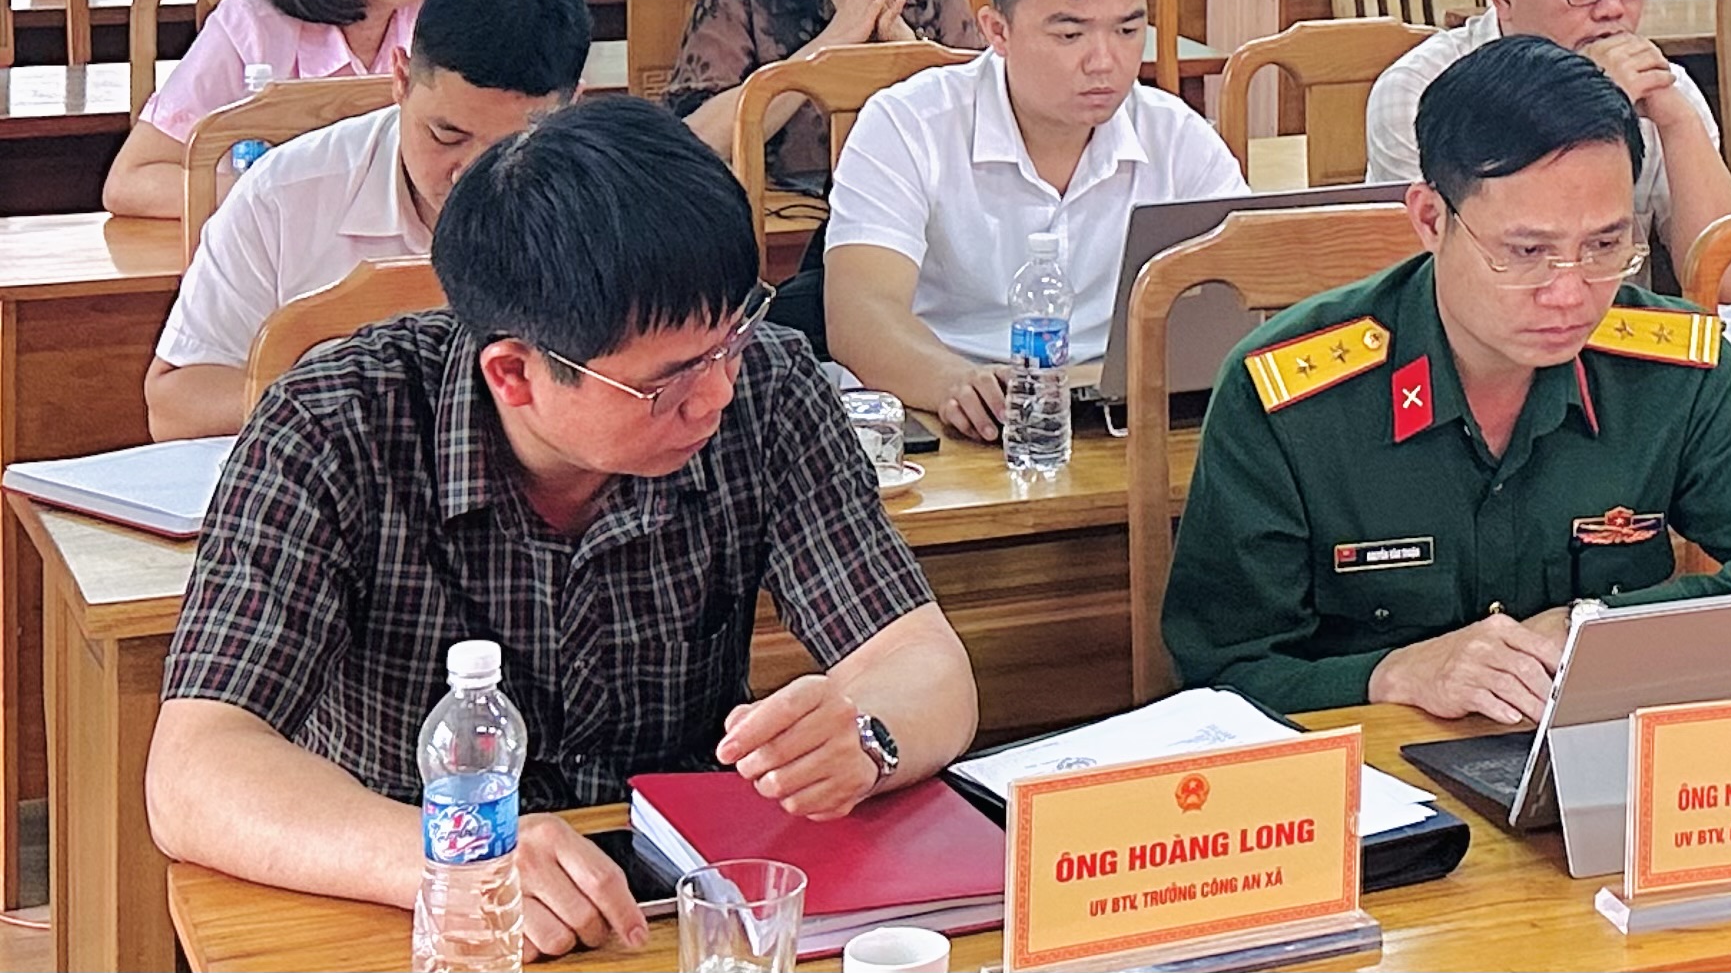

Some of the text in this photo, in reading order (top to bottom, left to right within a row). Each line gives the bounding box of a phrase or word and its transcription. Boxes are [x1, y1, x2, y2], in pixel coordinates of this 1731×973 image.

[1677, 783, 1719, 812] ÔNG
[1055, 818, 1315, 883] ÔNG HOÀNG LONG
[1674, 830, 1694, 848] UV
[1697, 827, 1725, 846] BTV,
[1089, 898, 1108, 917] UV
[1111, 893, 1139, 914] BTV,
[1200, 876, 1238, 899] CÔNG
[1241, 873, 1262, 892] AN
